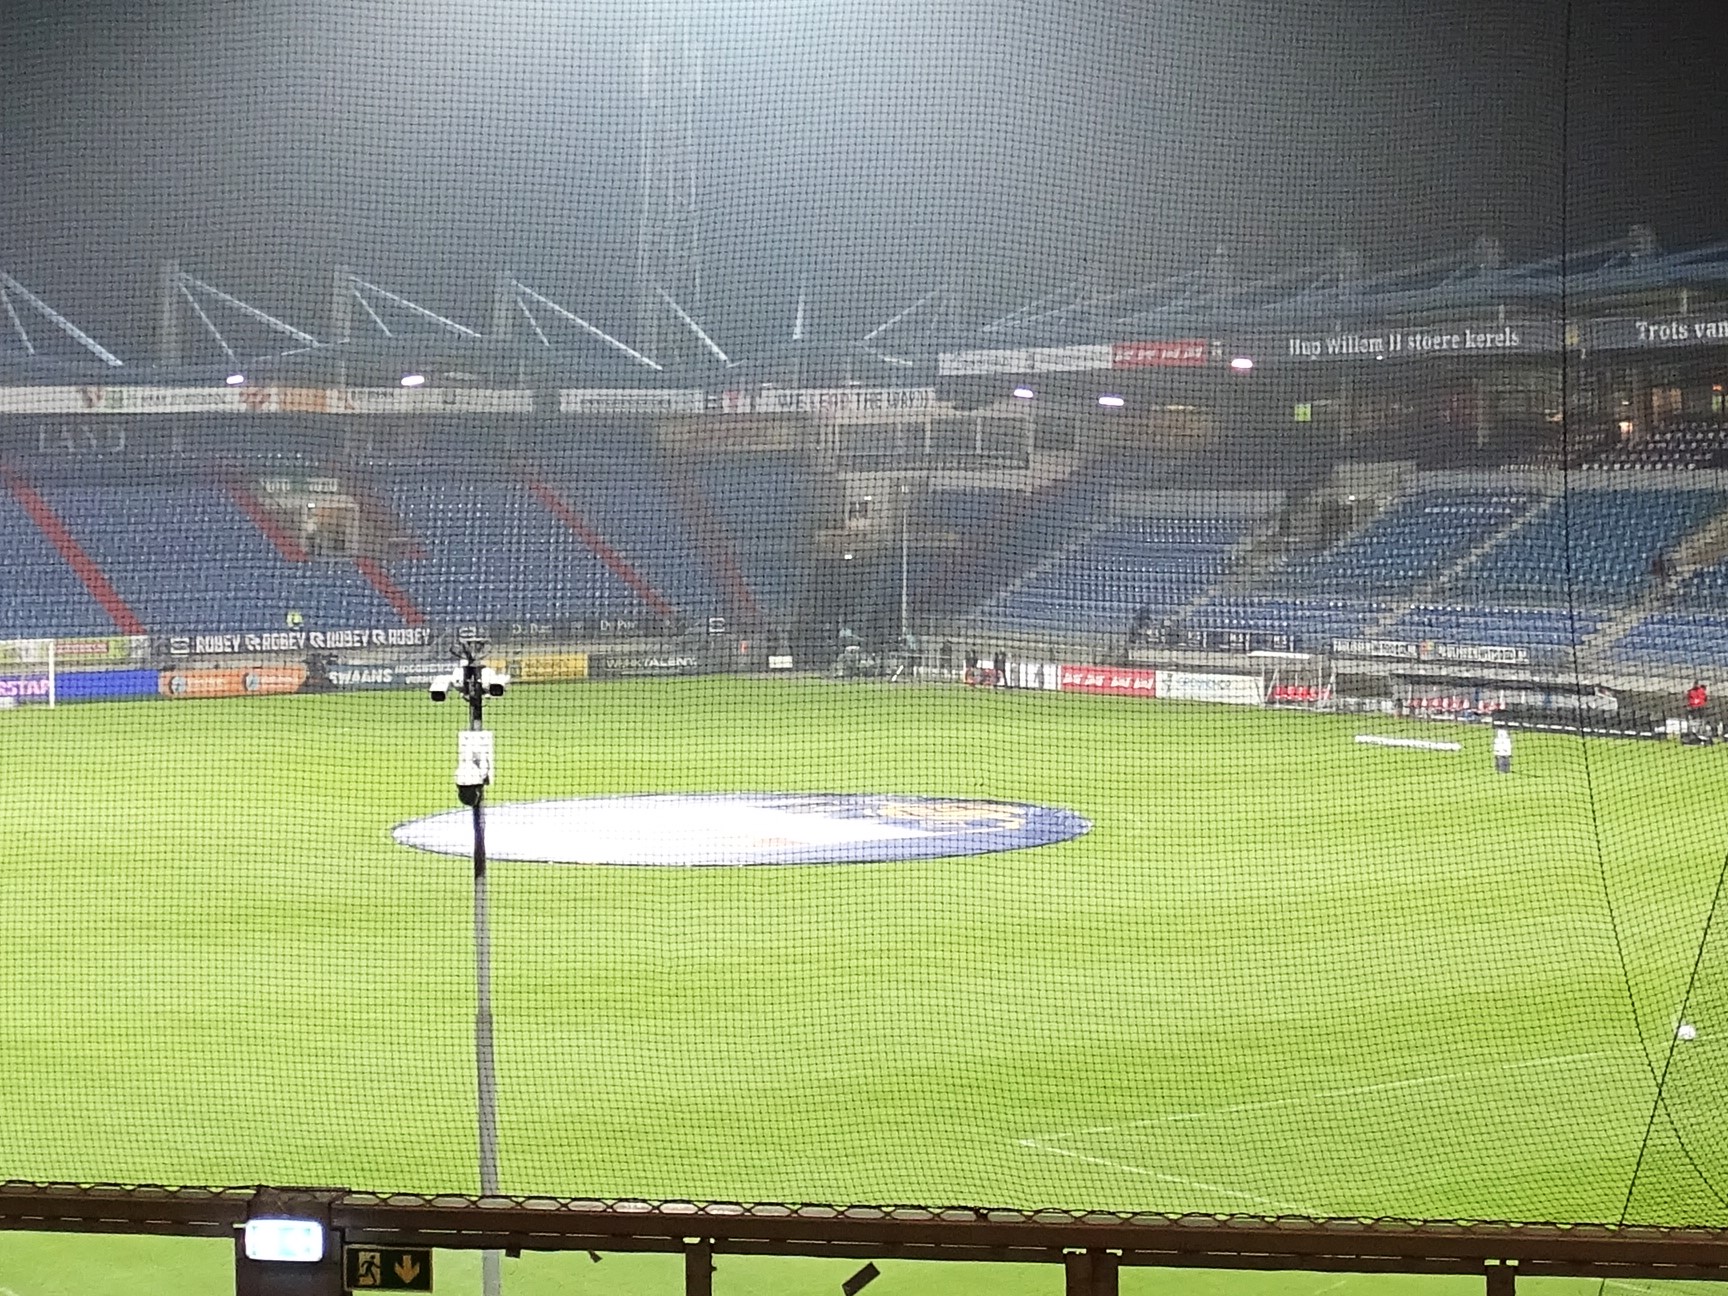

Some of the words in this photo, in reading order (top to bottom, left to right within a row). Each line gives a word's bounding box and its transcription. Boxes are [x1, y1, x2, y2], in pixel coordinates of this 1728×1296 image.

[1326, 334, 1383, 356] Willem
[1406, 332, 1460, 352] stoere
[1465, 326, 1520, 349] kerels
[1636, 320, 1689, 342] Trots
